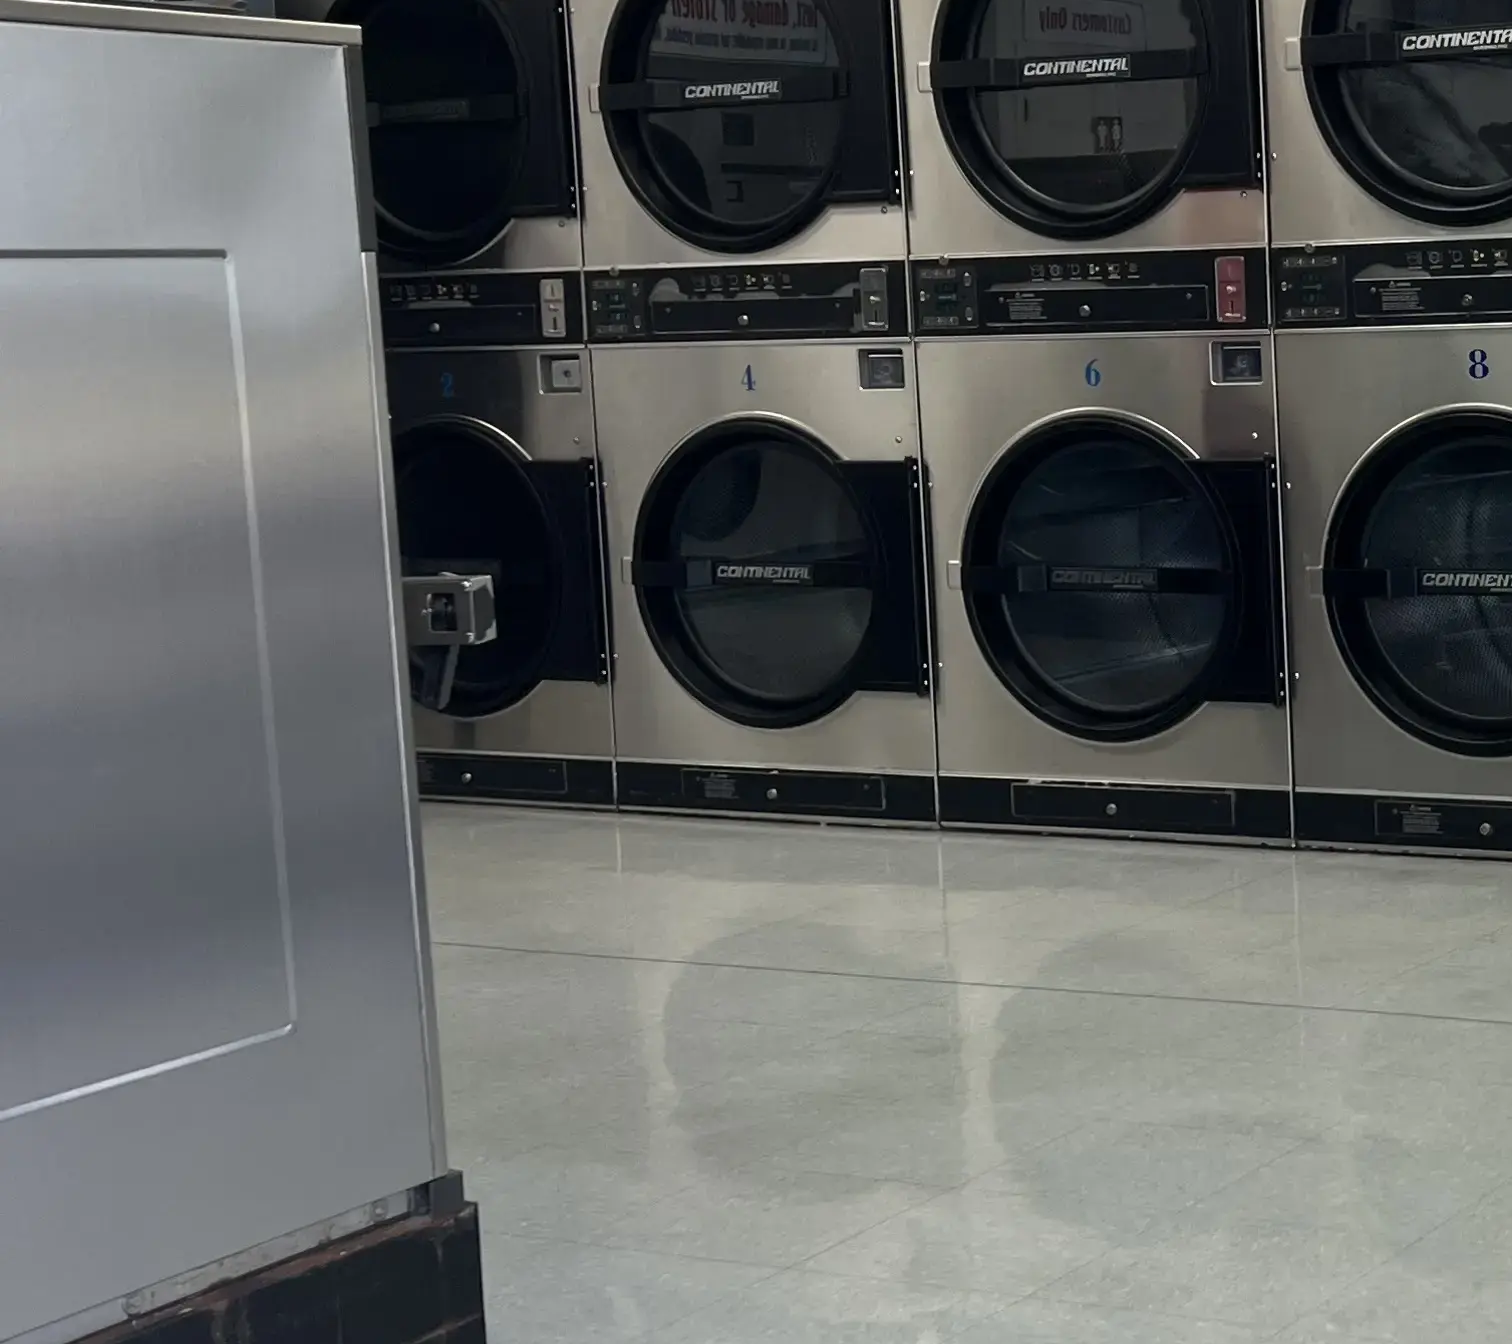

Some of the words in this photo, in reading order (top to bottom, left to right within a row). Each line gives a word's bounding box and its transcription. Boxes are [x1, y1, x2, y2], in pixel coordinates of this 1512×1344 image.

[1023, 57, 1129, 77] CONTINENTAL
[684, 80, 780, 99] CONTINENTAL
[741, 364, 756, 392] 4
[1084, 358, 1101, 388] 6
[1467, 348, 1490, 380] 8
